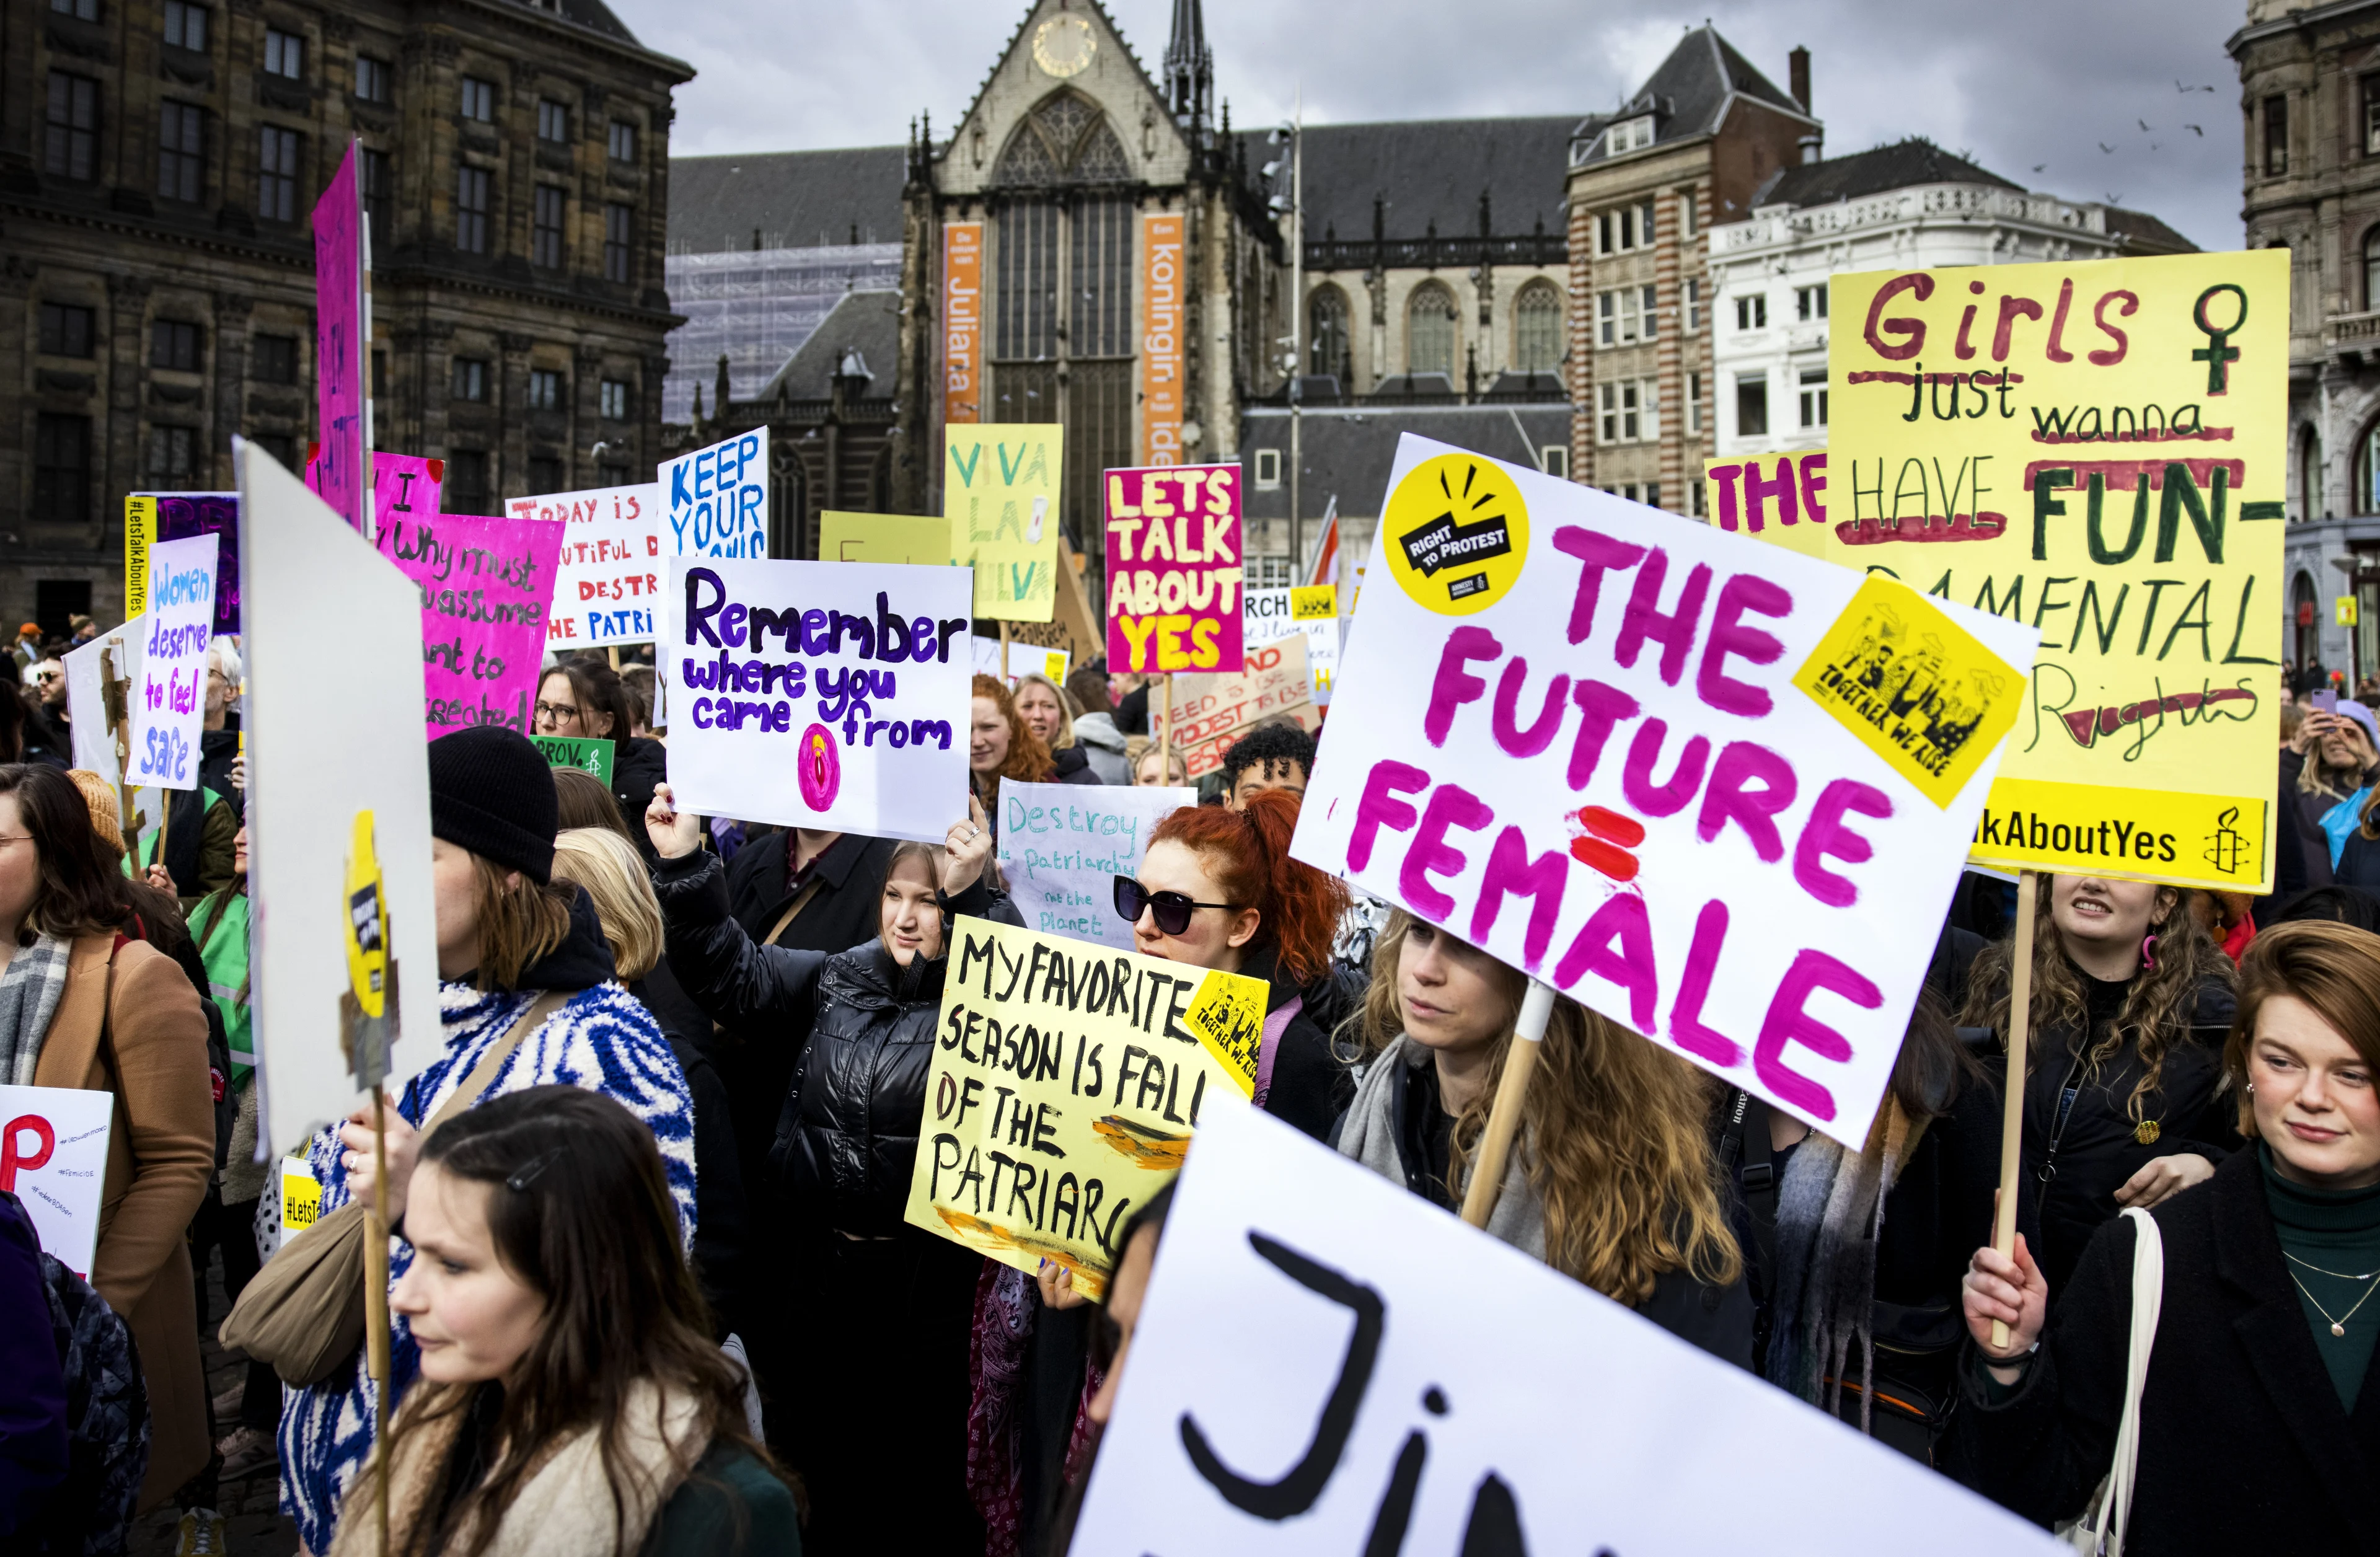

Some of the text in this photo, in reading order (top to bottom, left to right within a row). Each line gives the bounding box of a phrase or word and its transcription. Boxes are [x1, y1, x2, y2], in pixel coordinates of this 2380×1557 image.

[948, 277, 977, 393] Juliana
[1145, 244, 1181, 383] koningin
[1863, 271, 2140, 366] Girls
[1902, 362, 2206, 441] just wanna
[672, 436, 759, 511] KEEP
[950, 442, 1048, 488] VIVA
[1109, 469, 1233, 519] LETS
[669, 485, 764, 556] YOUR
[970, 496, 1021, 543] LA
[1108, 515, 1235, 563] TALK
[1409, 525, 1452, 557] RIGHT
[1853, 456, 2286, 565] HAVE FUN-
[129, 501, 144, 612] #LetsTalkAboutYes
[393, 520, 538, 592] Why must
[558, 539, 631, 567] UTiFUL
[1422, 529, 1505, 567] TO PROTEST
[154, 562, 209, 613] Women
[685, 567, 967, 663] Remember
[1109, 567, 1243, 617] ABOUT
[1245, 595, 1287, 618] RCH
[1451, 580, 1474, 592] AMNESTY
[1866, 565, 2282, 666] MENTAL
[148, 619, 207, 659] deserve
[548, 607, 653, 640] HE PATRi
[1119, 614, 1221, 672] YES
[1552, 525, 1794, 719] THE
[145, 667, 198, 715] to feel
[472, 645, 506, 680] to
[682, 649, 806, 699] where
[814, 666, 896, 723] you
[1243, 648, 1281, 679] ND
[1315, 668, 1331, 692] H
[692, 697, 952, 750] came from
[1154, 695, 1217, 731] NEED
[1820, 663, 1890, 732] TOGETHER
[1890, 721, 1919, 750] WE
[1911, 743, 1952, 777] RISE
[2024, 663, 2259, 762] Rights
[1426, 625, 1895, 908] FUTURE
[1008, 796, 1137, 860] Destroy
[1067, 891, 1092, 905] the
[1346, 759, 1885, 1123] FEMALE
[958, 933, 1199, 1047] MY FAVORITE
[941, 1004, 1063, 1081] SEASON
[1072, 1034, 1104, 1097] IS
[1197, 1007, 1232, 1053] TOGETHER
[1231, 1046, 1246, 1065] WE
[937, 1071, 1067, 1158] OF THE
[0, 1114, 55, 1193] P
